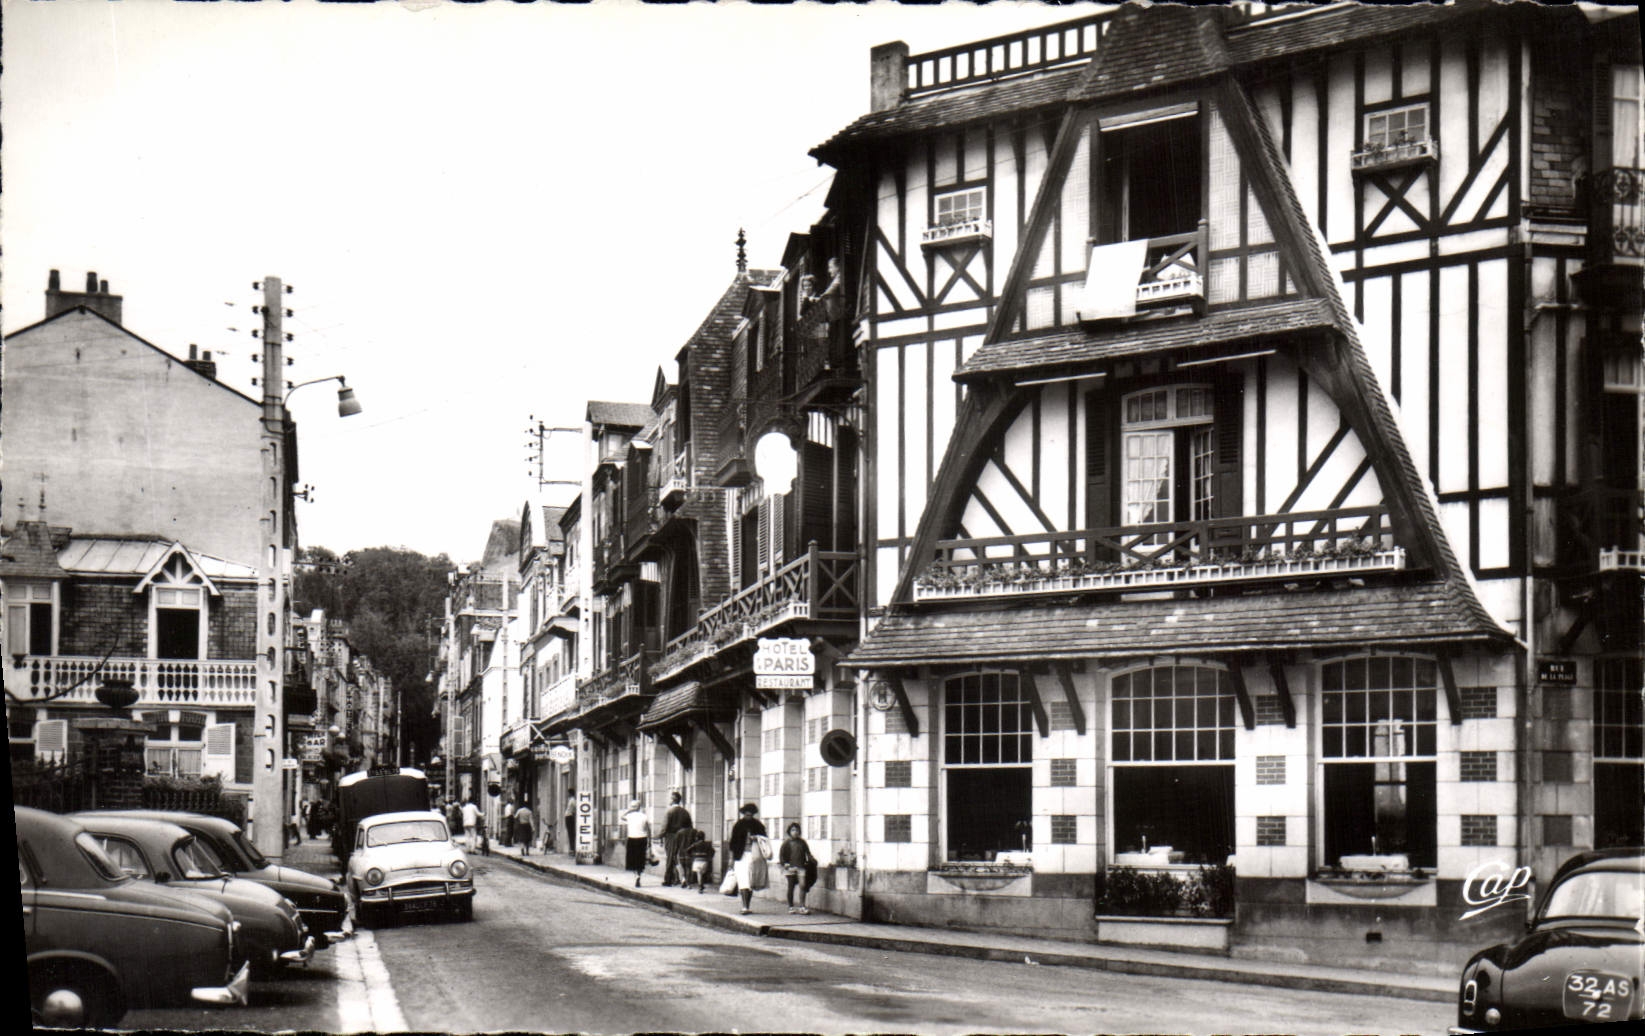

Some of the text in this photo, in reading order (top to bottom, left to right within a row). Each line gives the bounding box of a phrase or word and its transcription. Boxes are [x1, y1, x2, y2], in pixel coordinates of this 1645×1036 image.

[762, 641, 808, 655] HOTEL
[763, 657, 809, 671] PARIS
[757, 677, 811, 688] RESTAURANT
[580, 793, 591, 845] HOTEL
[1568, 975, 1630, 997] 32 AS
[1582, 1001, 1612, 1018] 72
